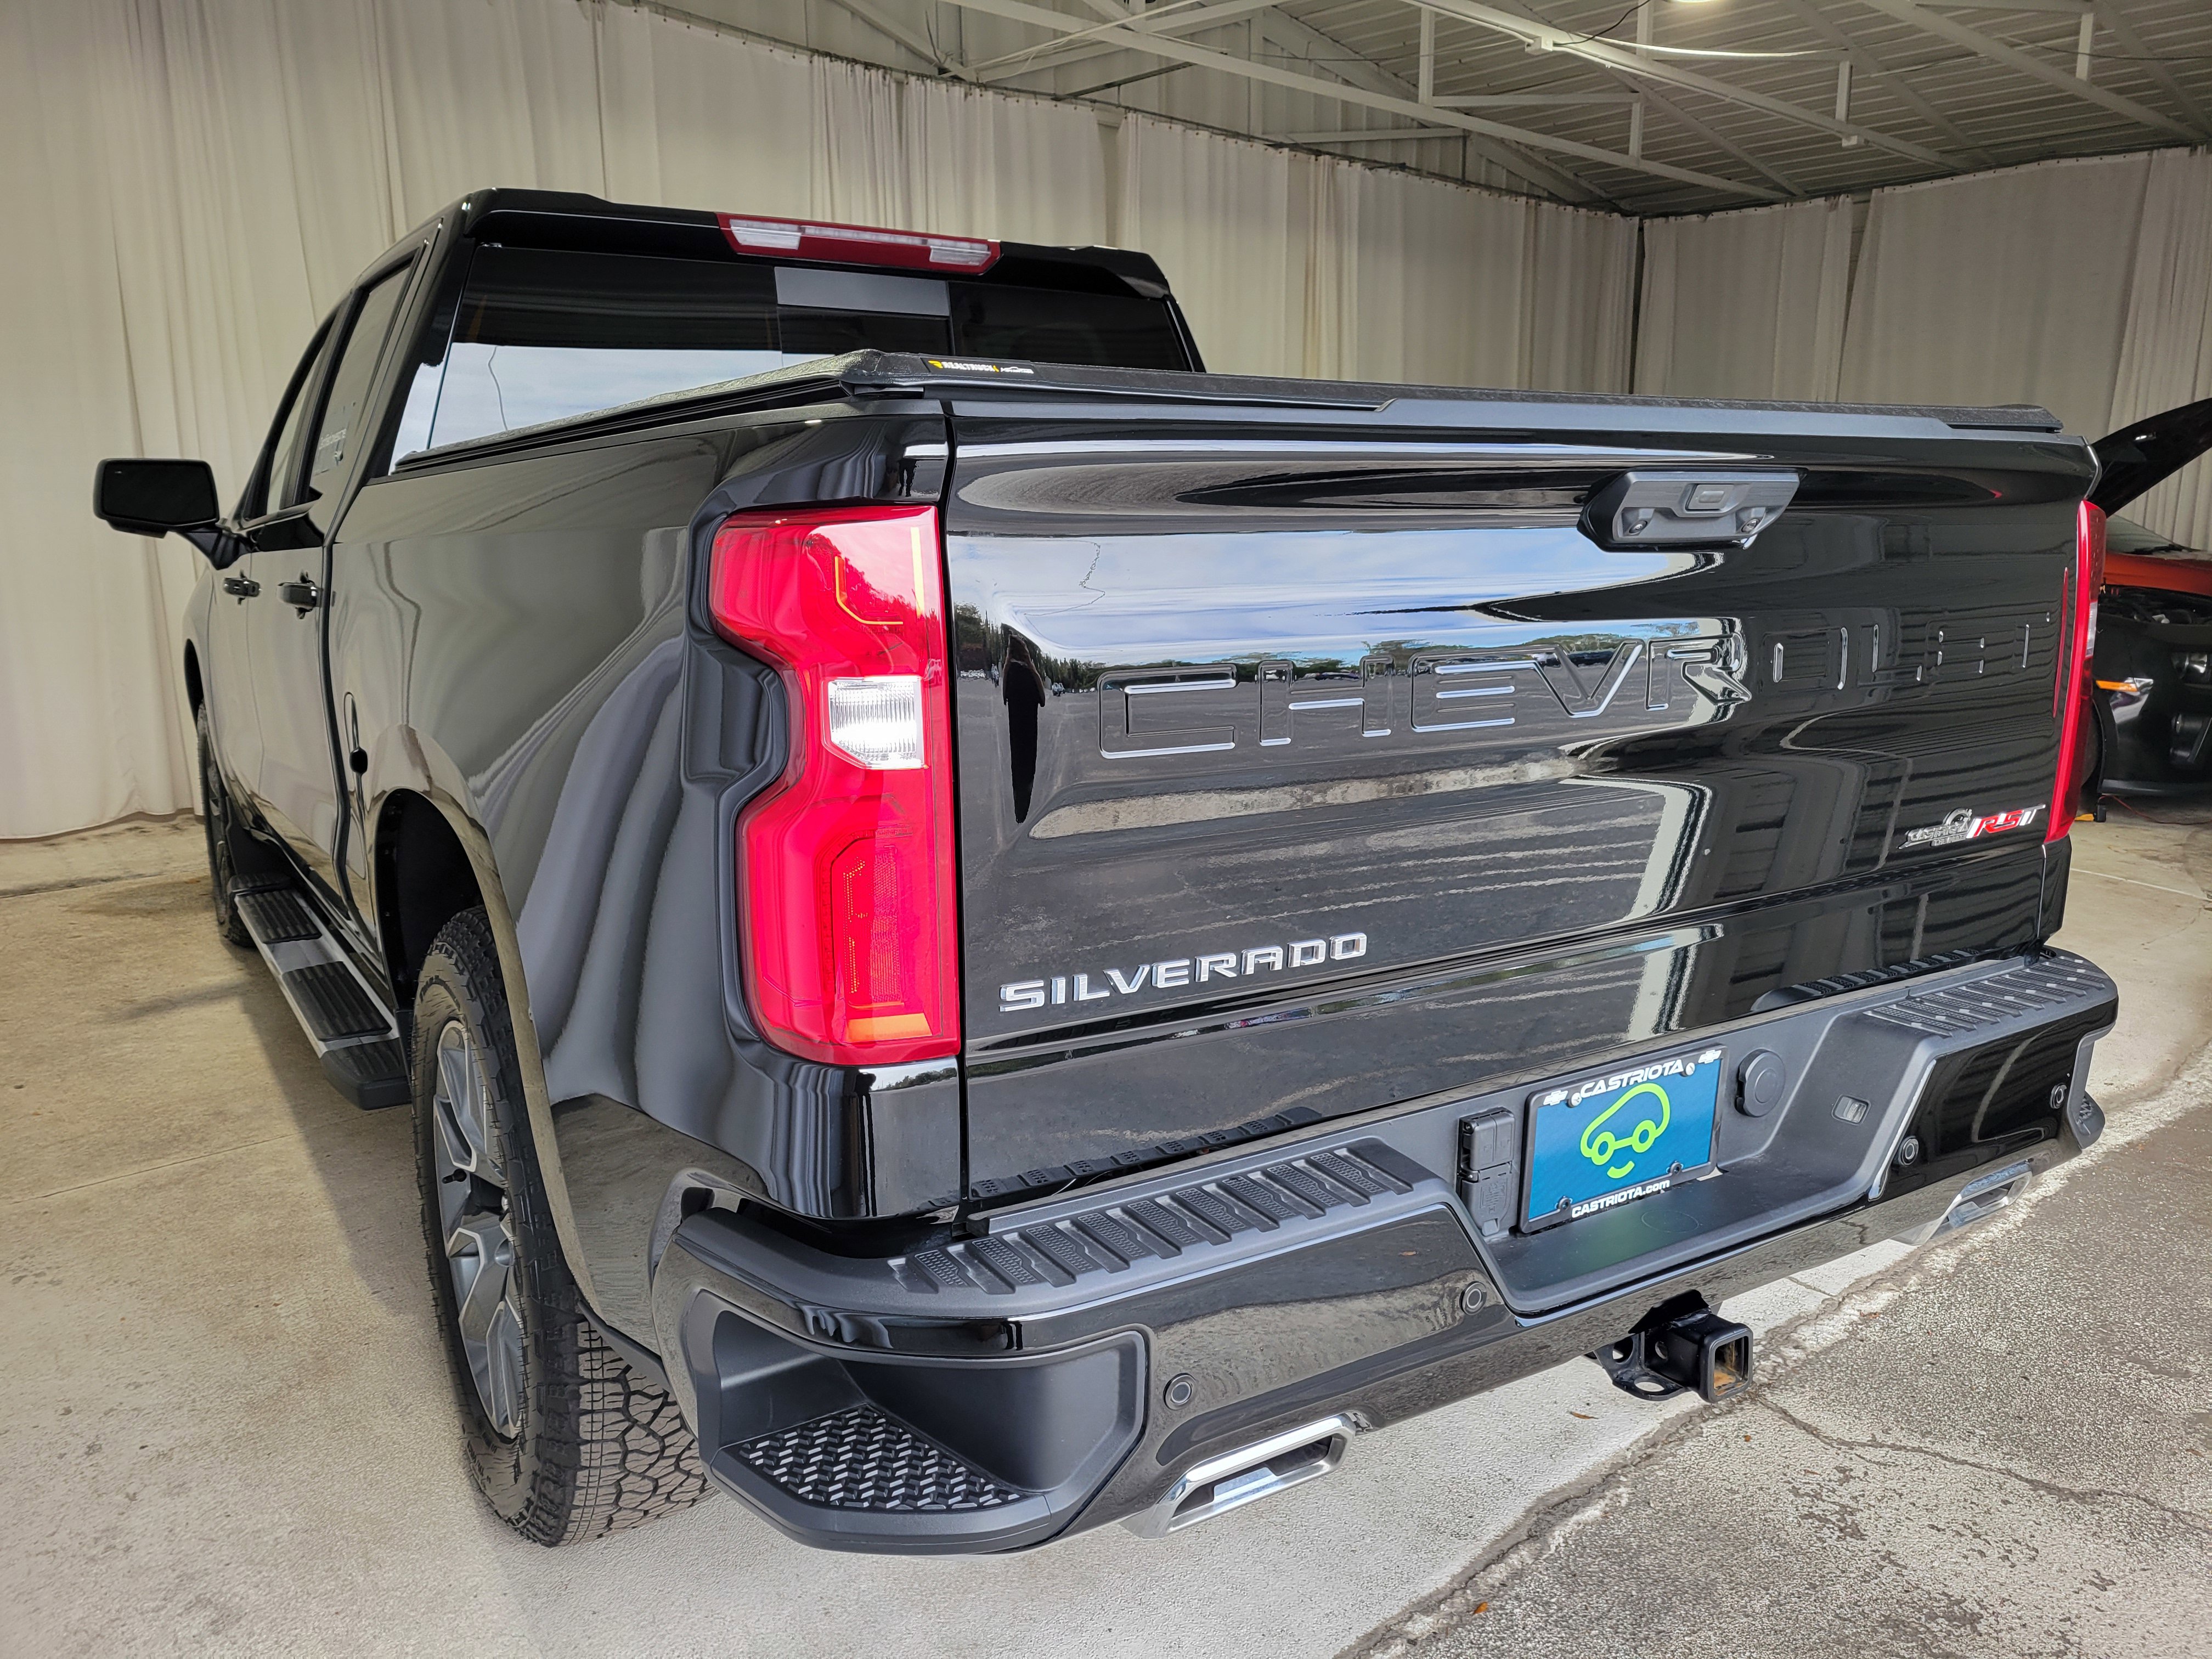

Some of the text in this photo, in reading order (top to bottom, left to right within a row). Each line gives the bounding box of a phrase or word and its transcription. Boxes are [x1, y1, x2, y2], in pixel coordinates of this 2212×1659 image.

[1966, 804, 2046, 839] RST
[999, 932, 1368, 1012] SILVERADO
[1579, 1059, 1684, 1098] CASTRIOTA
[1571, 1180, 1671, 1218] CASTRIOTA.com
